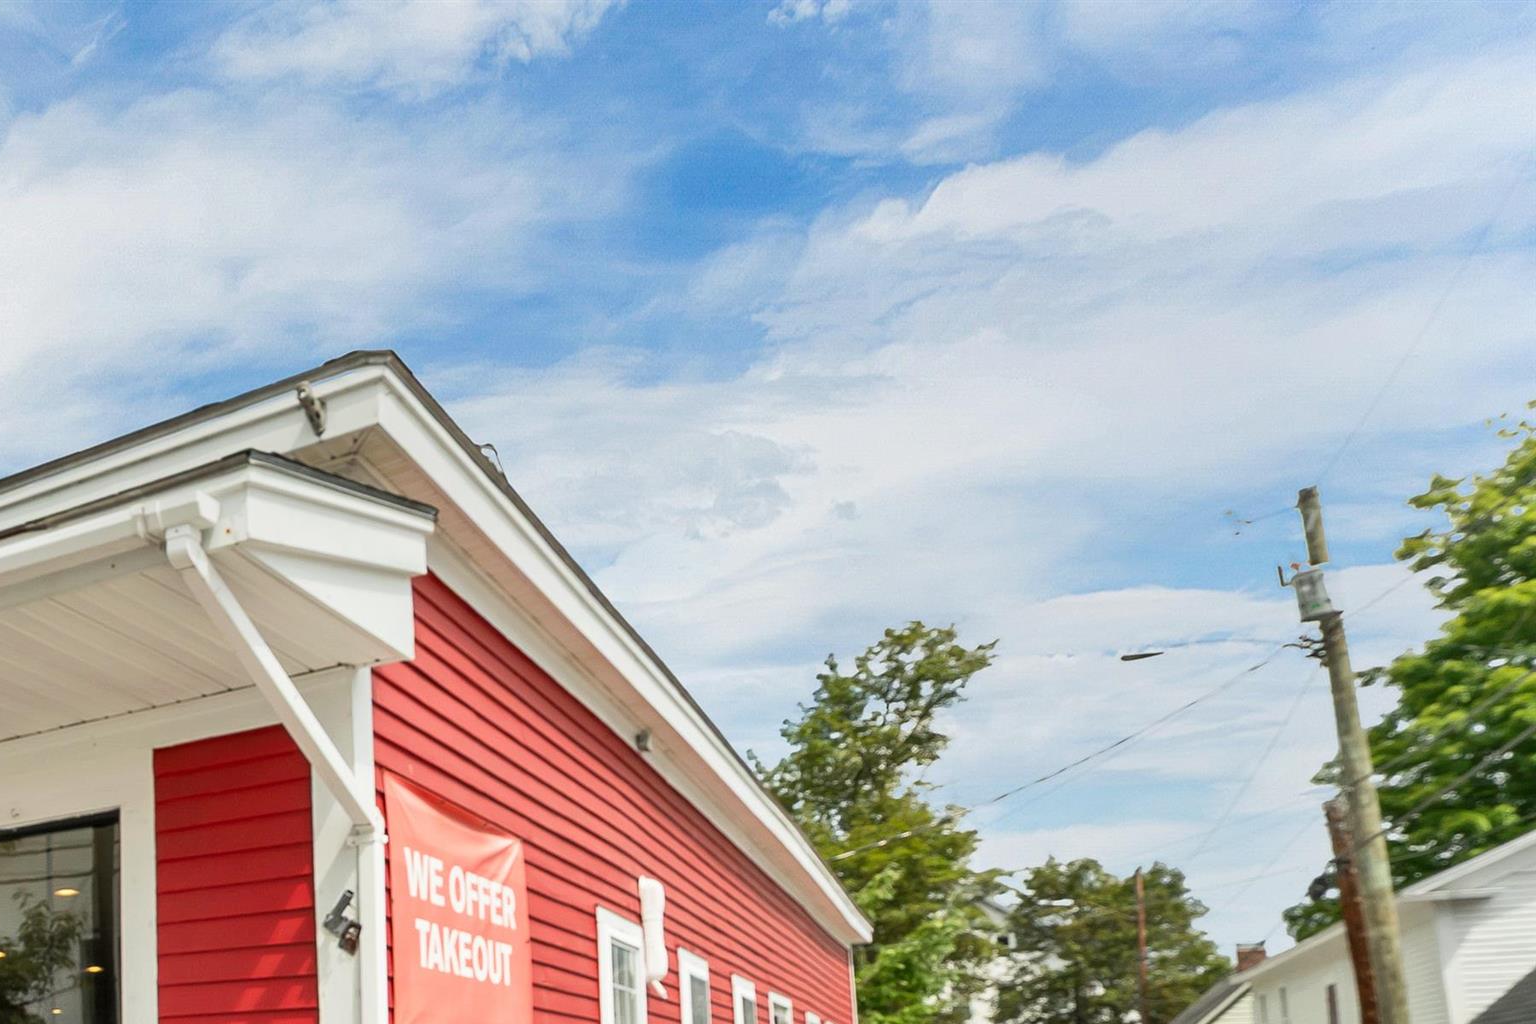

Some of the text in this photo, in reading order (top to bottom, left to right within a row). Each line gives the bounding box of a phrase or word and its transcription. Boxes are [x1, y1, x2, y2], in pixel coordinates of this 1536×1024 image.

[403, 847, 518, 930] WE OFFER
[415, 917, 513, 986] TAKEOUT
